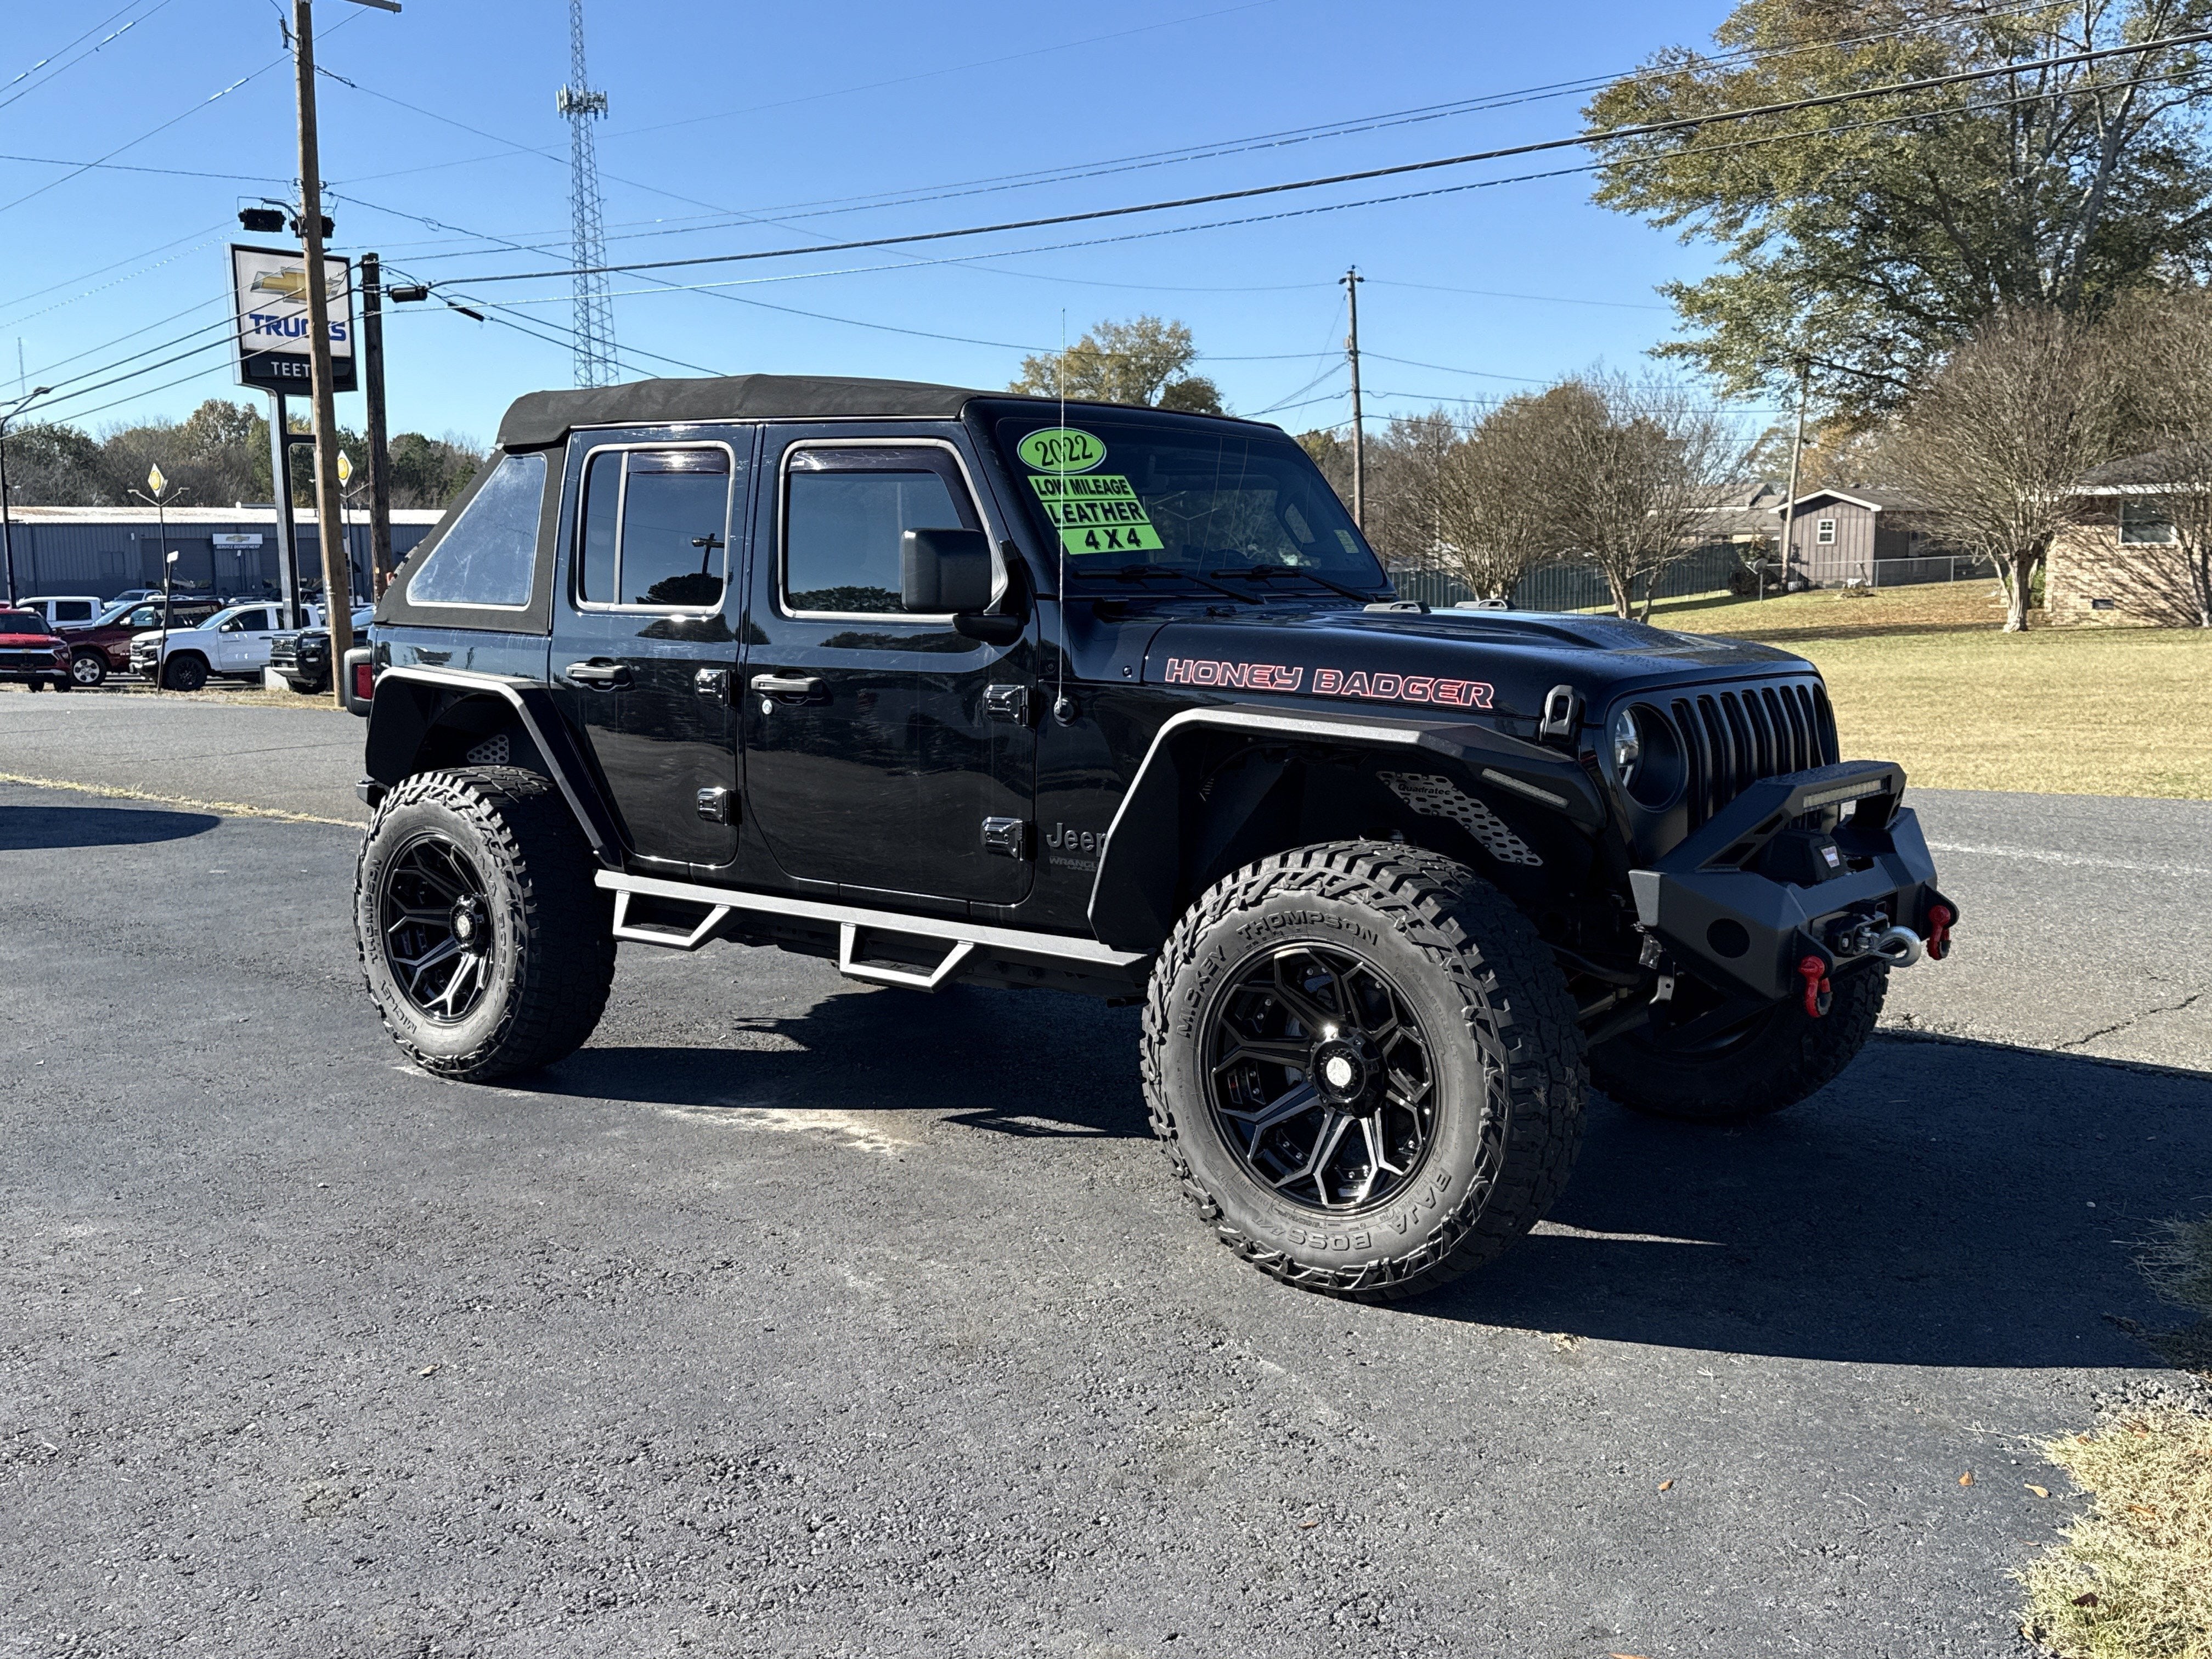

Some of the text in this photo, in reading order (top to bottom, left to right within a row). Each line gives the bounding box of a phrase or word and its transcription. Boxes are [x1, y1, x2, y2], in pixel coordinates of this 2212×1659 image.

[249, 314, 346, 341] TRUCS
[271, 362, 311, 377] TEET
[1035, 435, 1093, 466] 2022
[1035, 479, 1131, 495] LOW MILEAGE
[1047, 501, 1145, 524] LEATHER
[1165, 658, 1494, 709] HONEY BADGER
[1398, 783, 1451, 795] Quadratec
[1046, 822, 1107, 857] Jeep
[1049, 856, 1098, 868] WRANGL
[1176, 944, 1227, 1039] MICKEY
[1236, 910, 1378, 946] THOMPSON
[1389, 1167, 1452, 1235] BAJA
[1286, 1226, 1372, 1251] BOSS
